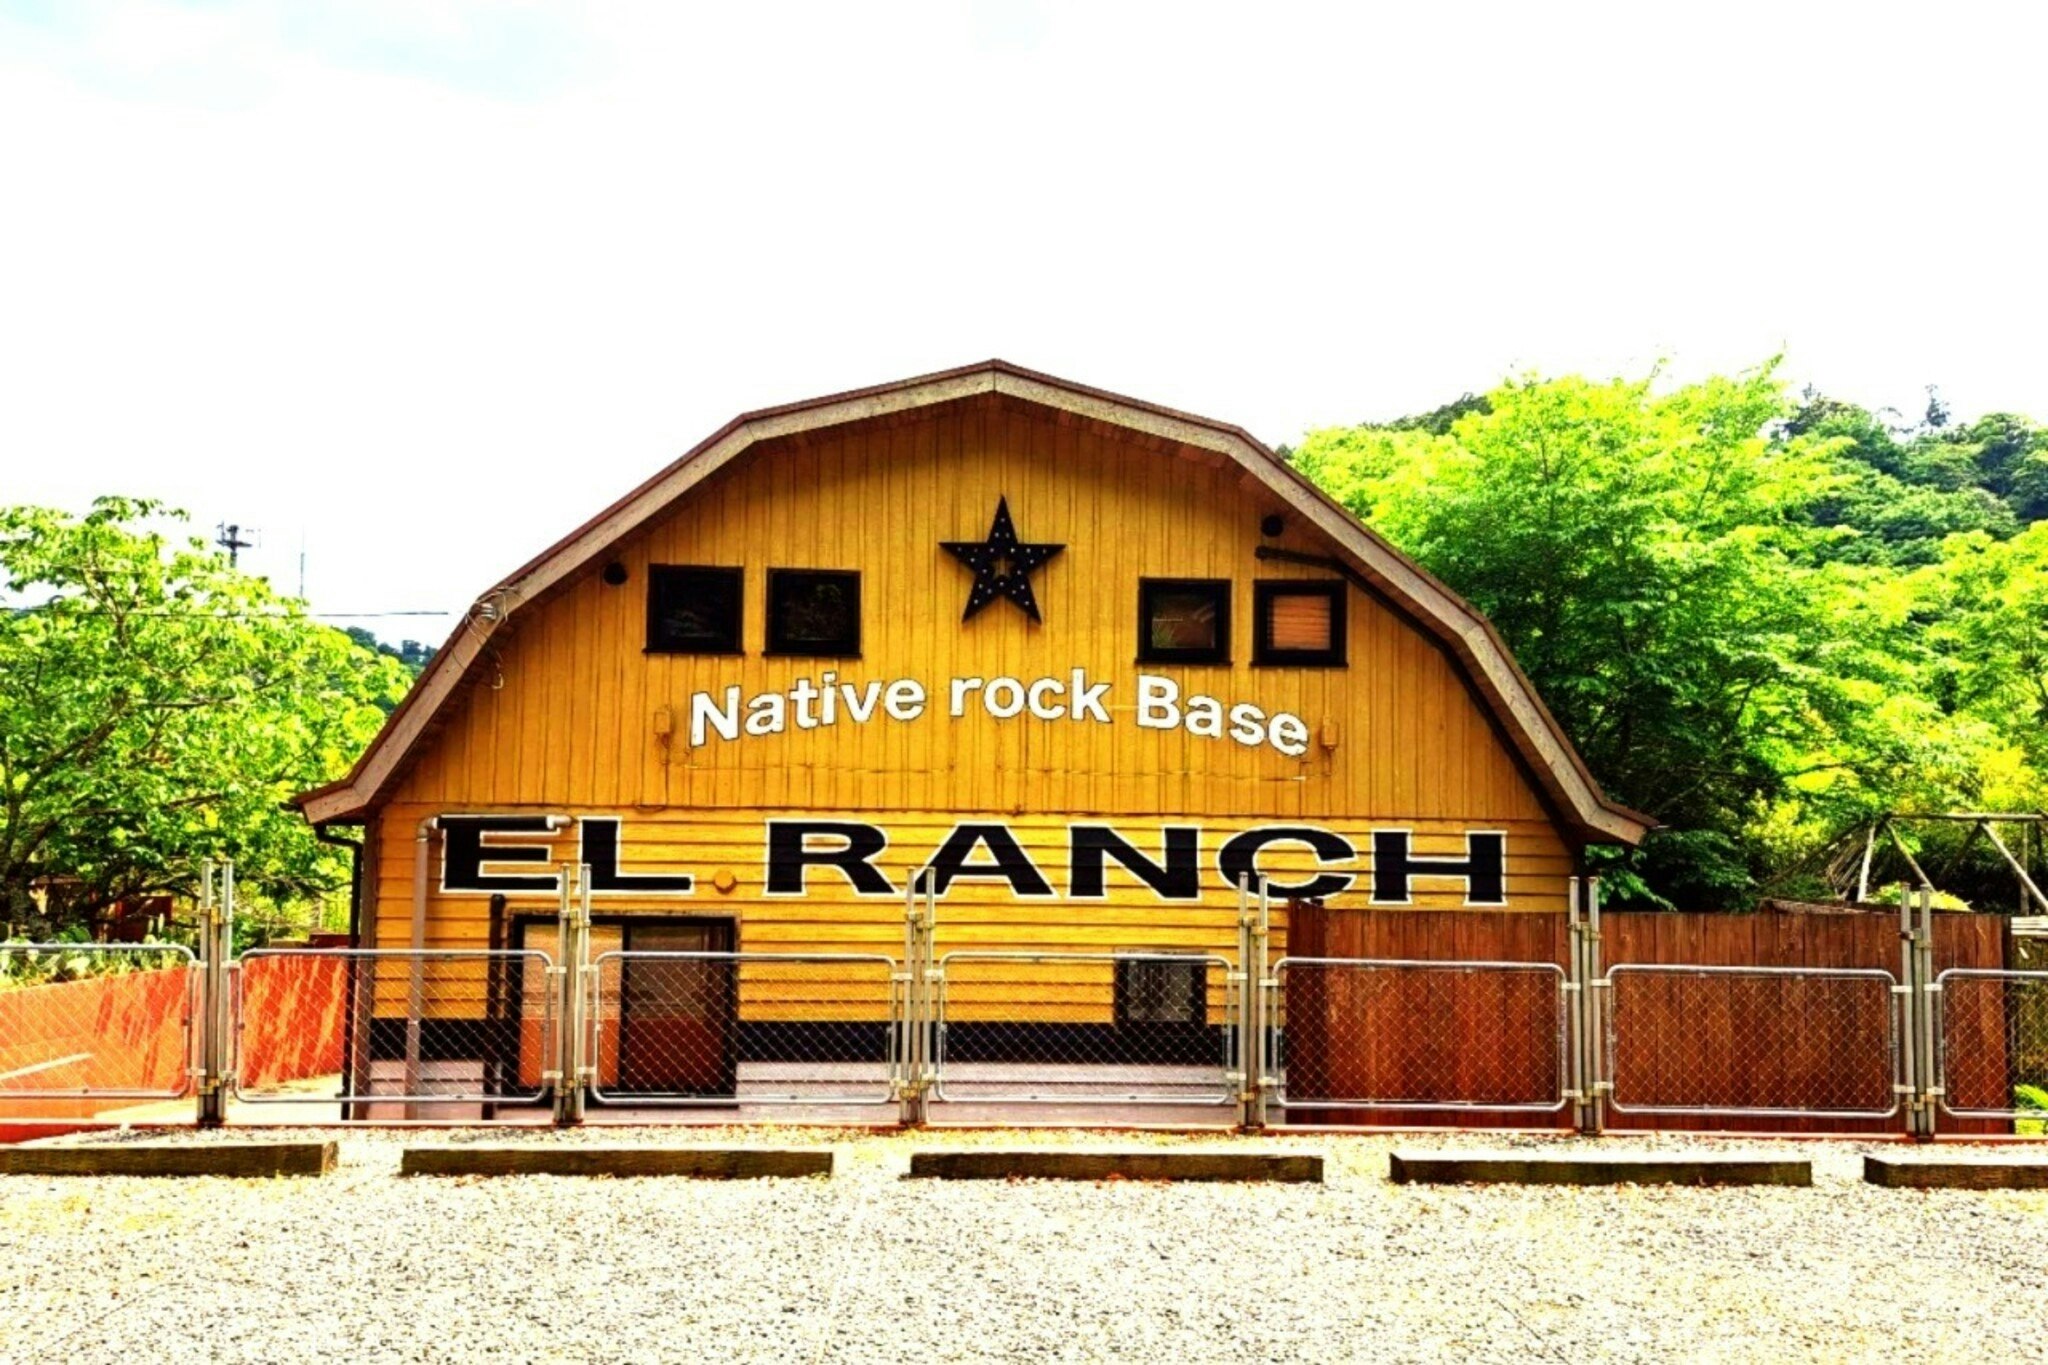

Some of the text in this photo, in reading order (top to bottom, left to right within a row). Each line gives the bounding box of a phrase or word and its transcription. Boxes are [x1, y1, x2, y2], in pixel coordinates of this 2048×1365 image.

[689, 667, 1310, 757] Native rock Base
[438, 815, 1508, 907] EL RANCH
